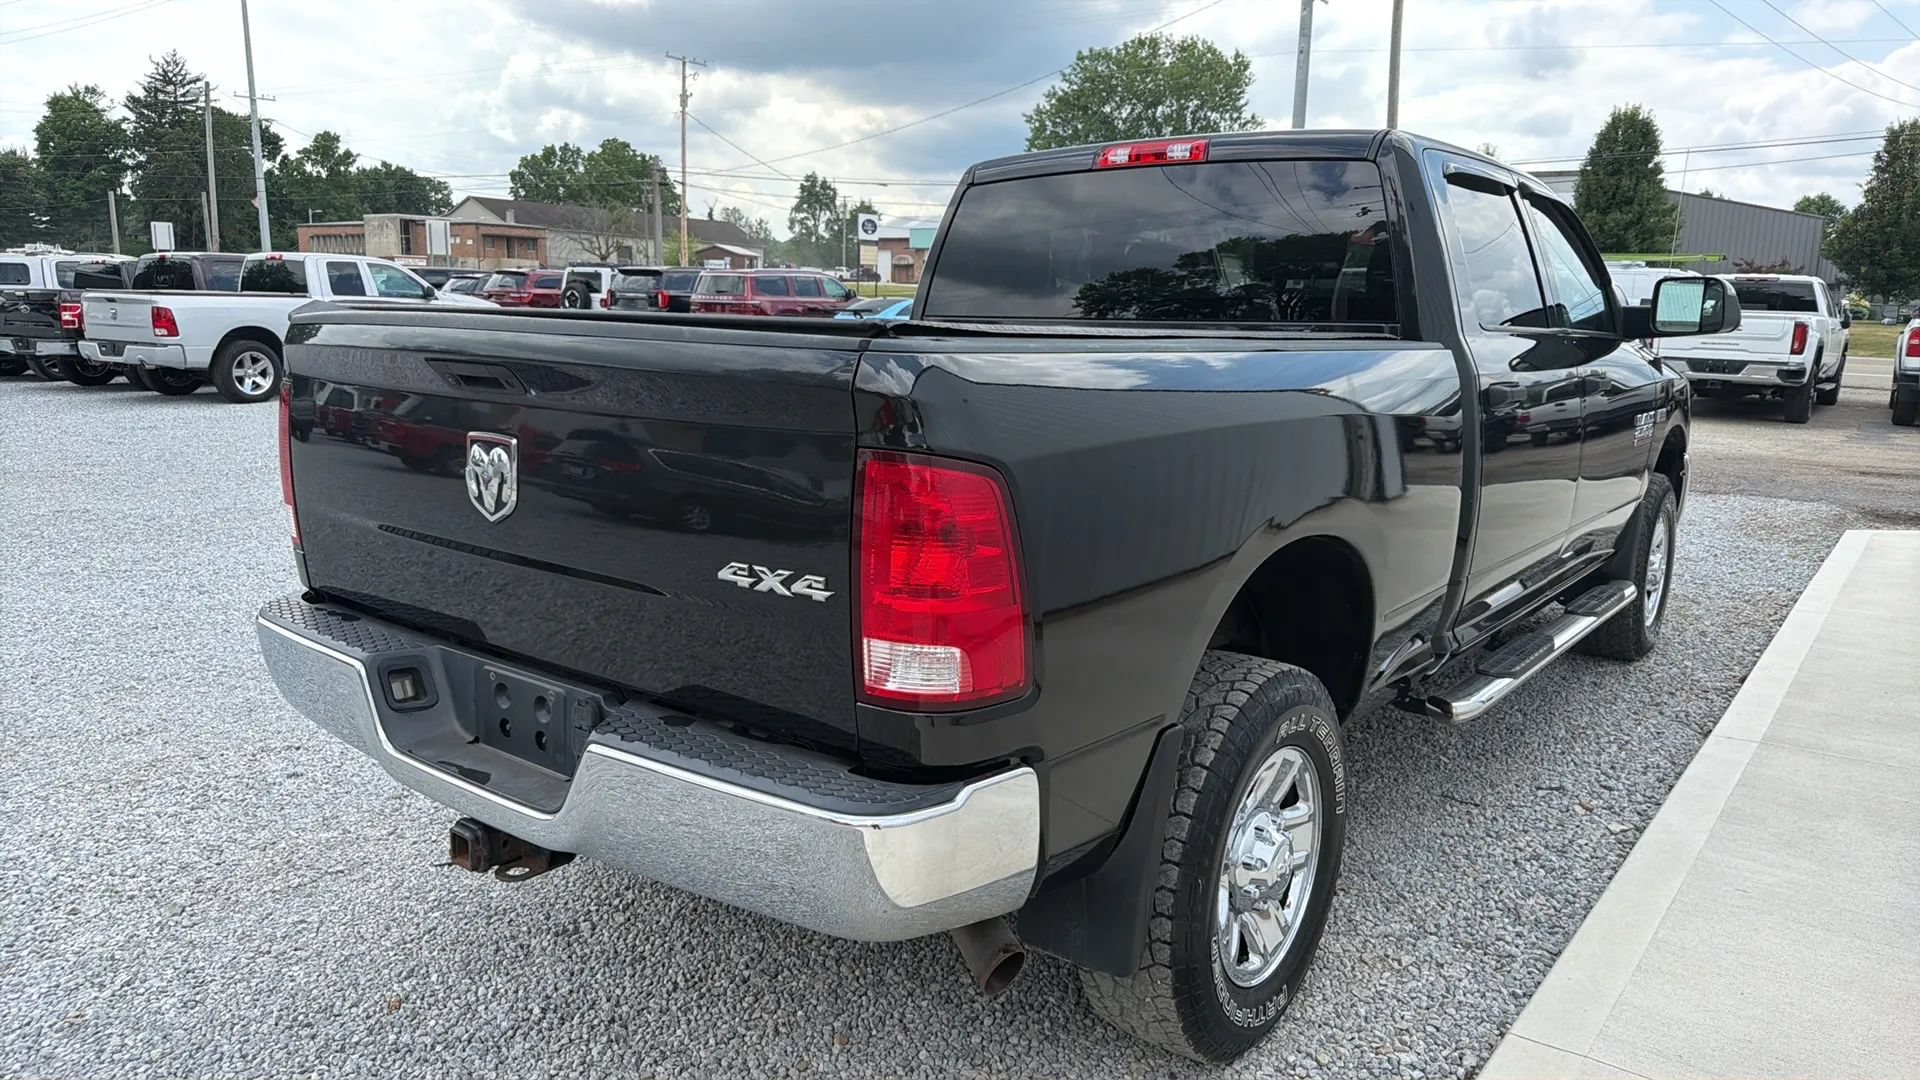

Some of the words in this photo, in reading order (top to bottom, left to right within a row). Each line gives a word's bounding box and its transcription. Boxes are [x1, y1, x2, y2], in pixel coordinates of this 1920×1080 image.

[717, 561, 836, 602] 4X4
[1276, 713, 1306, 744] ALL
[1309, 715, 1346, 814] TERRAIN
[1210, 935, 1288, 1028] PATHFINDER
